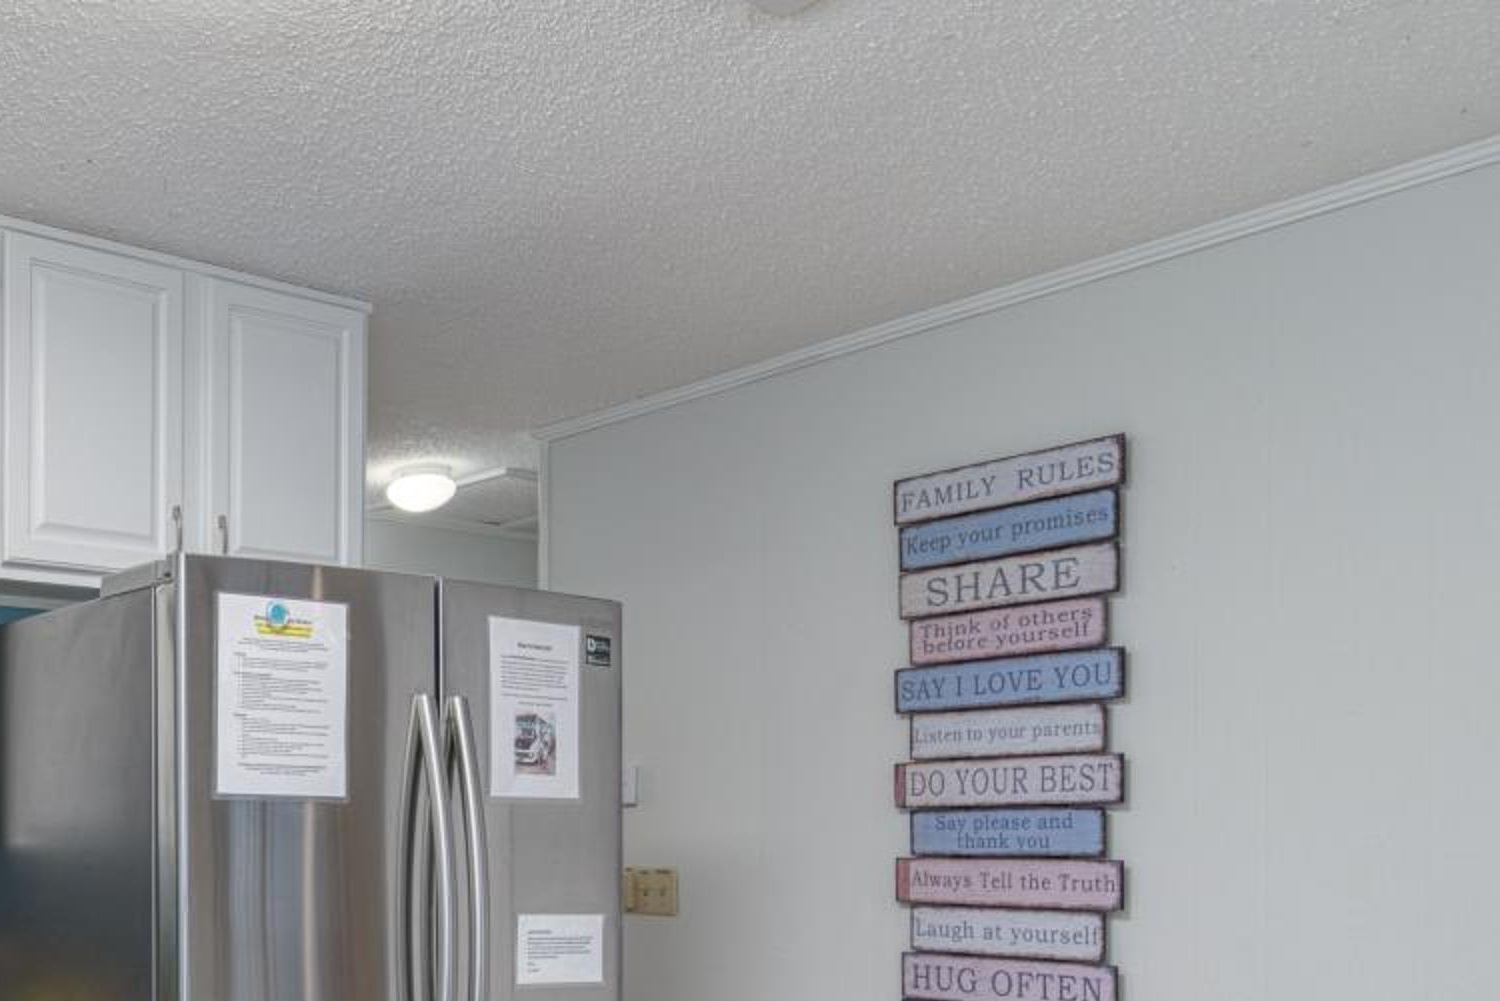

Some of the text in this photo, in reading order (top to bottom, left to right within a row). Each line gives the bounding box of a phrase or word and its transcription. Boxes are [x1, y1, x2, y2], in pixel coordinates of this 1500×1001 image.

[901, 452, 1116, 512] FAMILY RULES
[905, 509, 1109, 556] Keep your promises
[926, 557, 1081, 607] SHARE
[918, 605, 1093, 642] Think of others
[922, 621, 1091, 655] before yourself
[900, 661, 1113, 701] SAY I LOVE YOU
[914, 720, 1101, 747] Listen to your parents
[910, 762, 1114, 798] DO YOUR BEST
[935, 811, 1074, 835] Say please and
[957, 833, 1050, 852] thank you
[912, 870, 1117, 894] Always Tell the Truth
[915, 917, 1098, 947] Laugh at yourself
[912, 963, 978, 994] HUG
